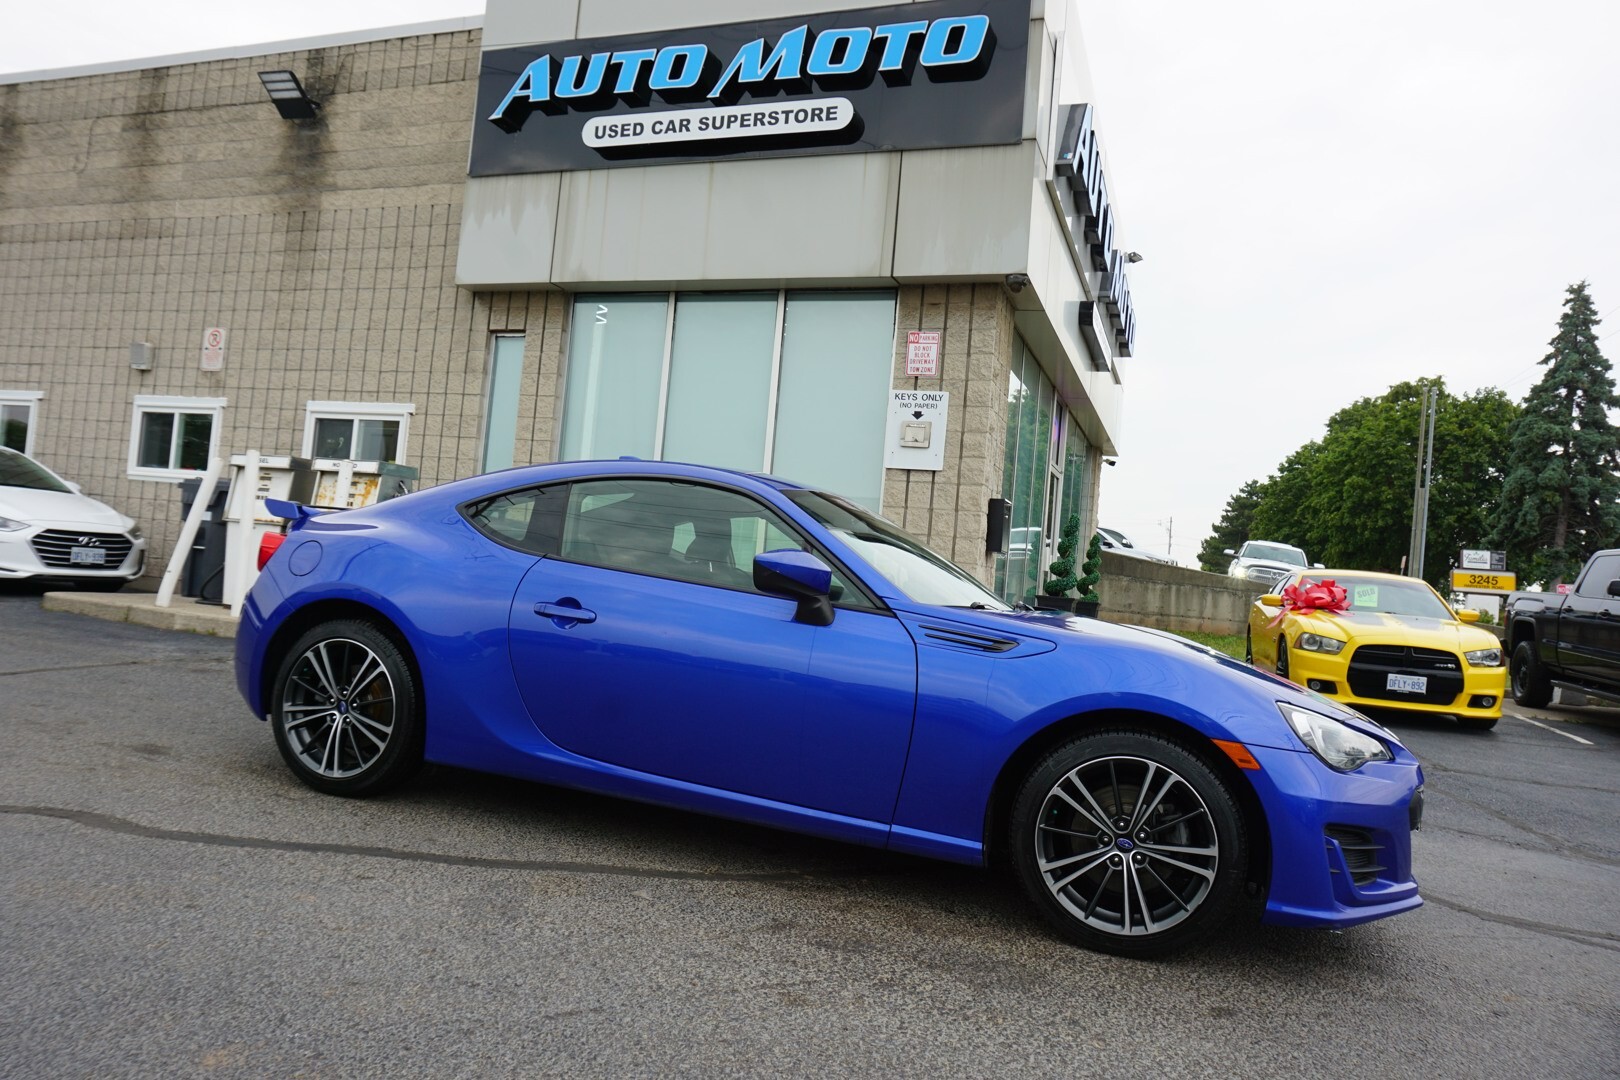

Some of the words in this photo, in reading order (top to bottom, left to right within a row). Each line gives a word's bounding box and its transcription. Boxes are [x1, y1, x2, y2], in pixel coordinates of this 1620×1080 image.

[488, 43, 708, 121] AUTO
[706, 14, 990, 98] MOTO
[593, 120, 644, 140] USED
[650, 117, 692, 134] CAR
[697, 105, 838, 132] SUPERSTORE
[909, 333, 919, 343] NO
[894, 393, 918, 401] KEYS
[921, 393, 944, 402] ONLY
[1469, 574, 1498, 586] 3245
[1357, 587, 1376, 599] SOLD
